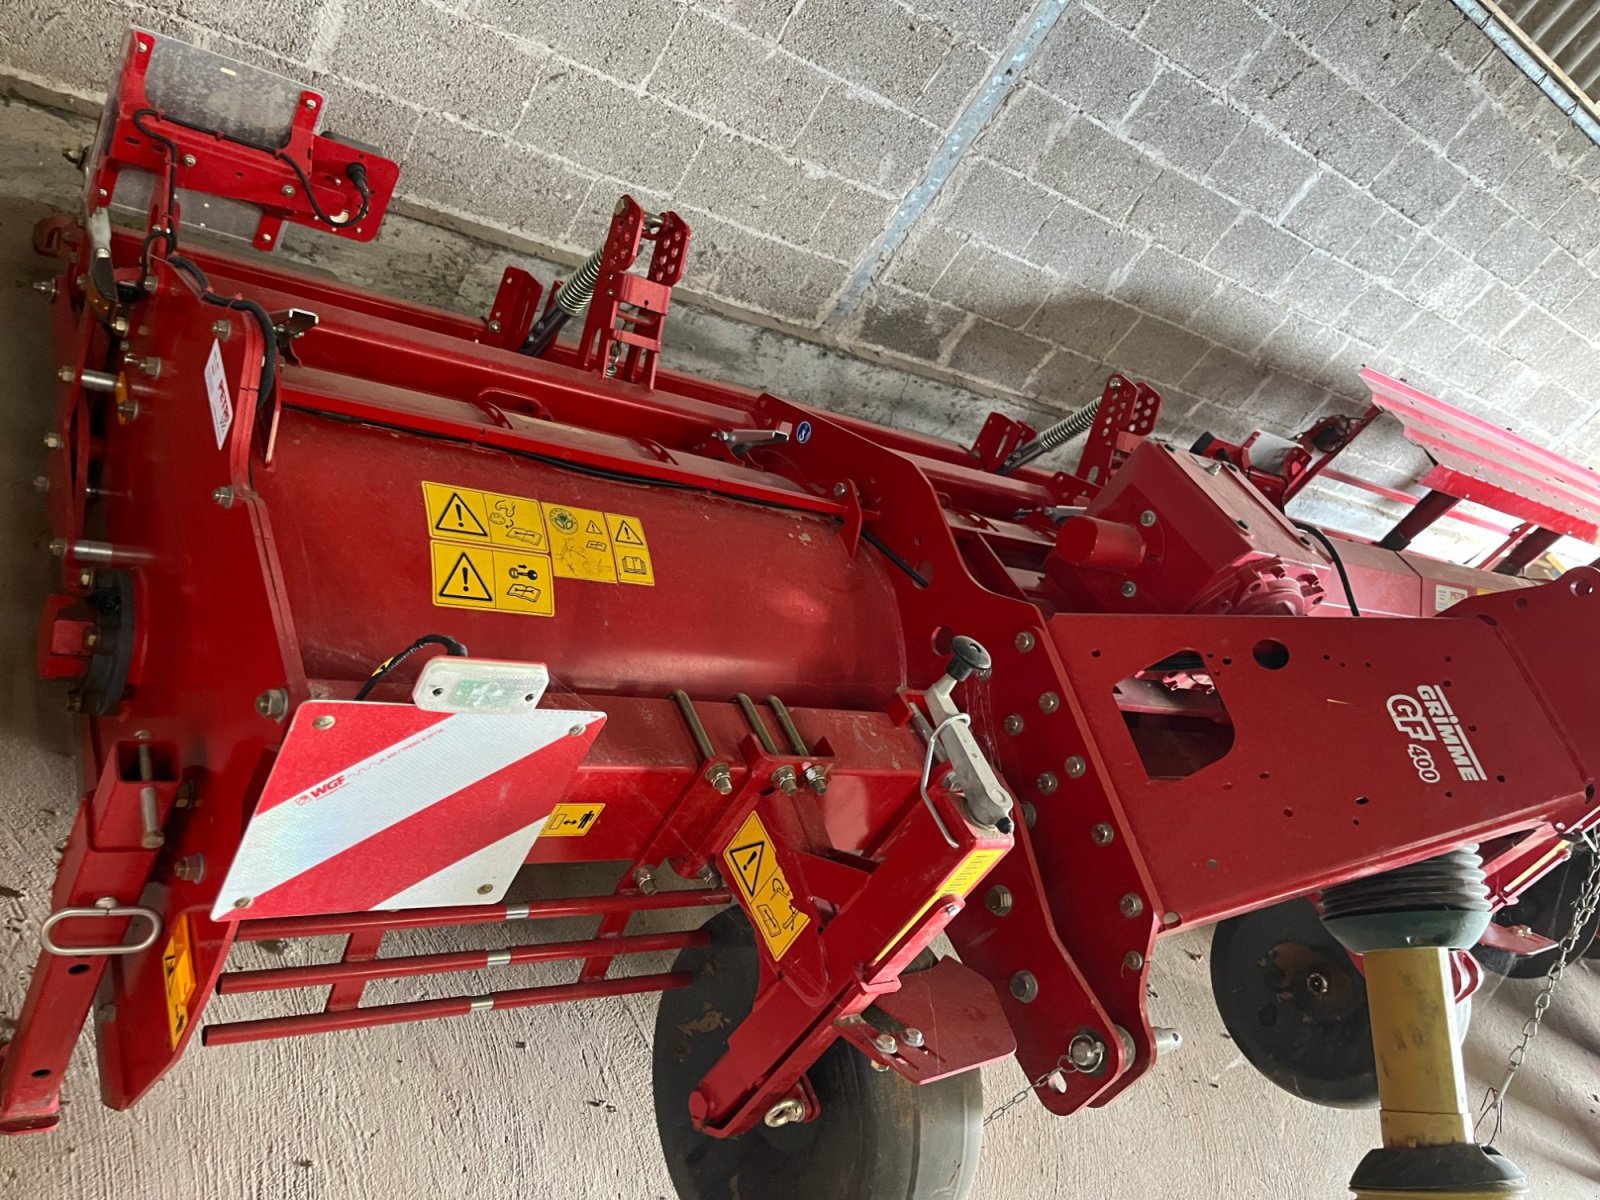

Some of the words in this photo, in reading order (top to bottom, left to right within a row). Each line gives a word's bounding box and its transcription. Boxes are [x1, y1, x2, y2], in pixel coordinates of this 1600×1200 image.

[1386, 694, 1437, 741] GF
[1417, 684, 1483, 781] GRIMME
[1407, 743, 1441, 784] 400
[310, 775, 345, 798] WGF
